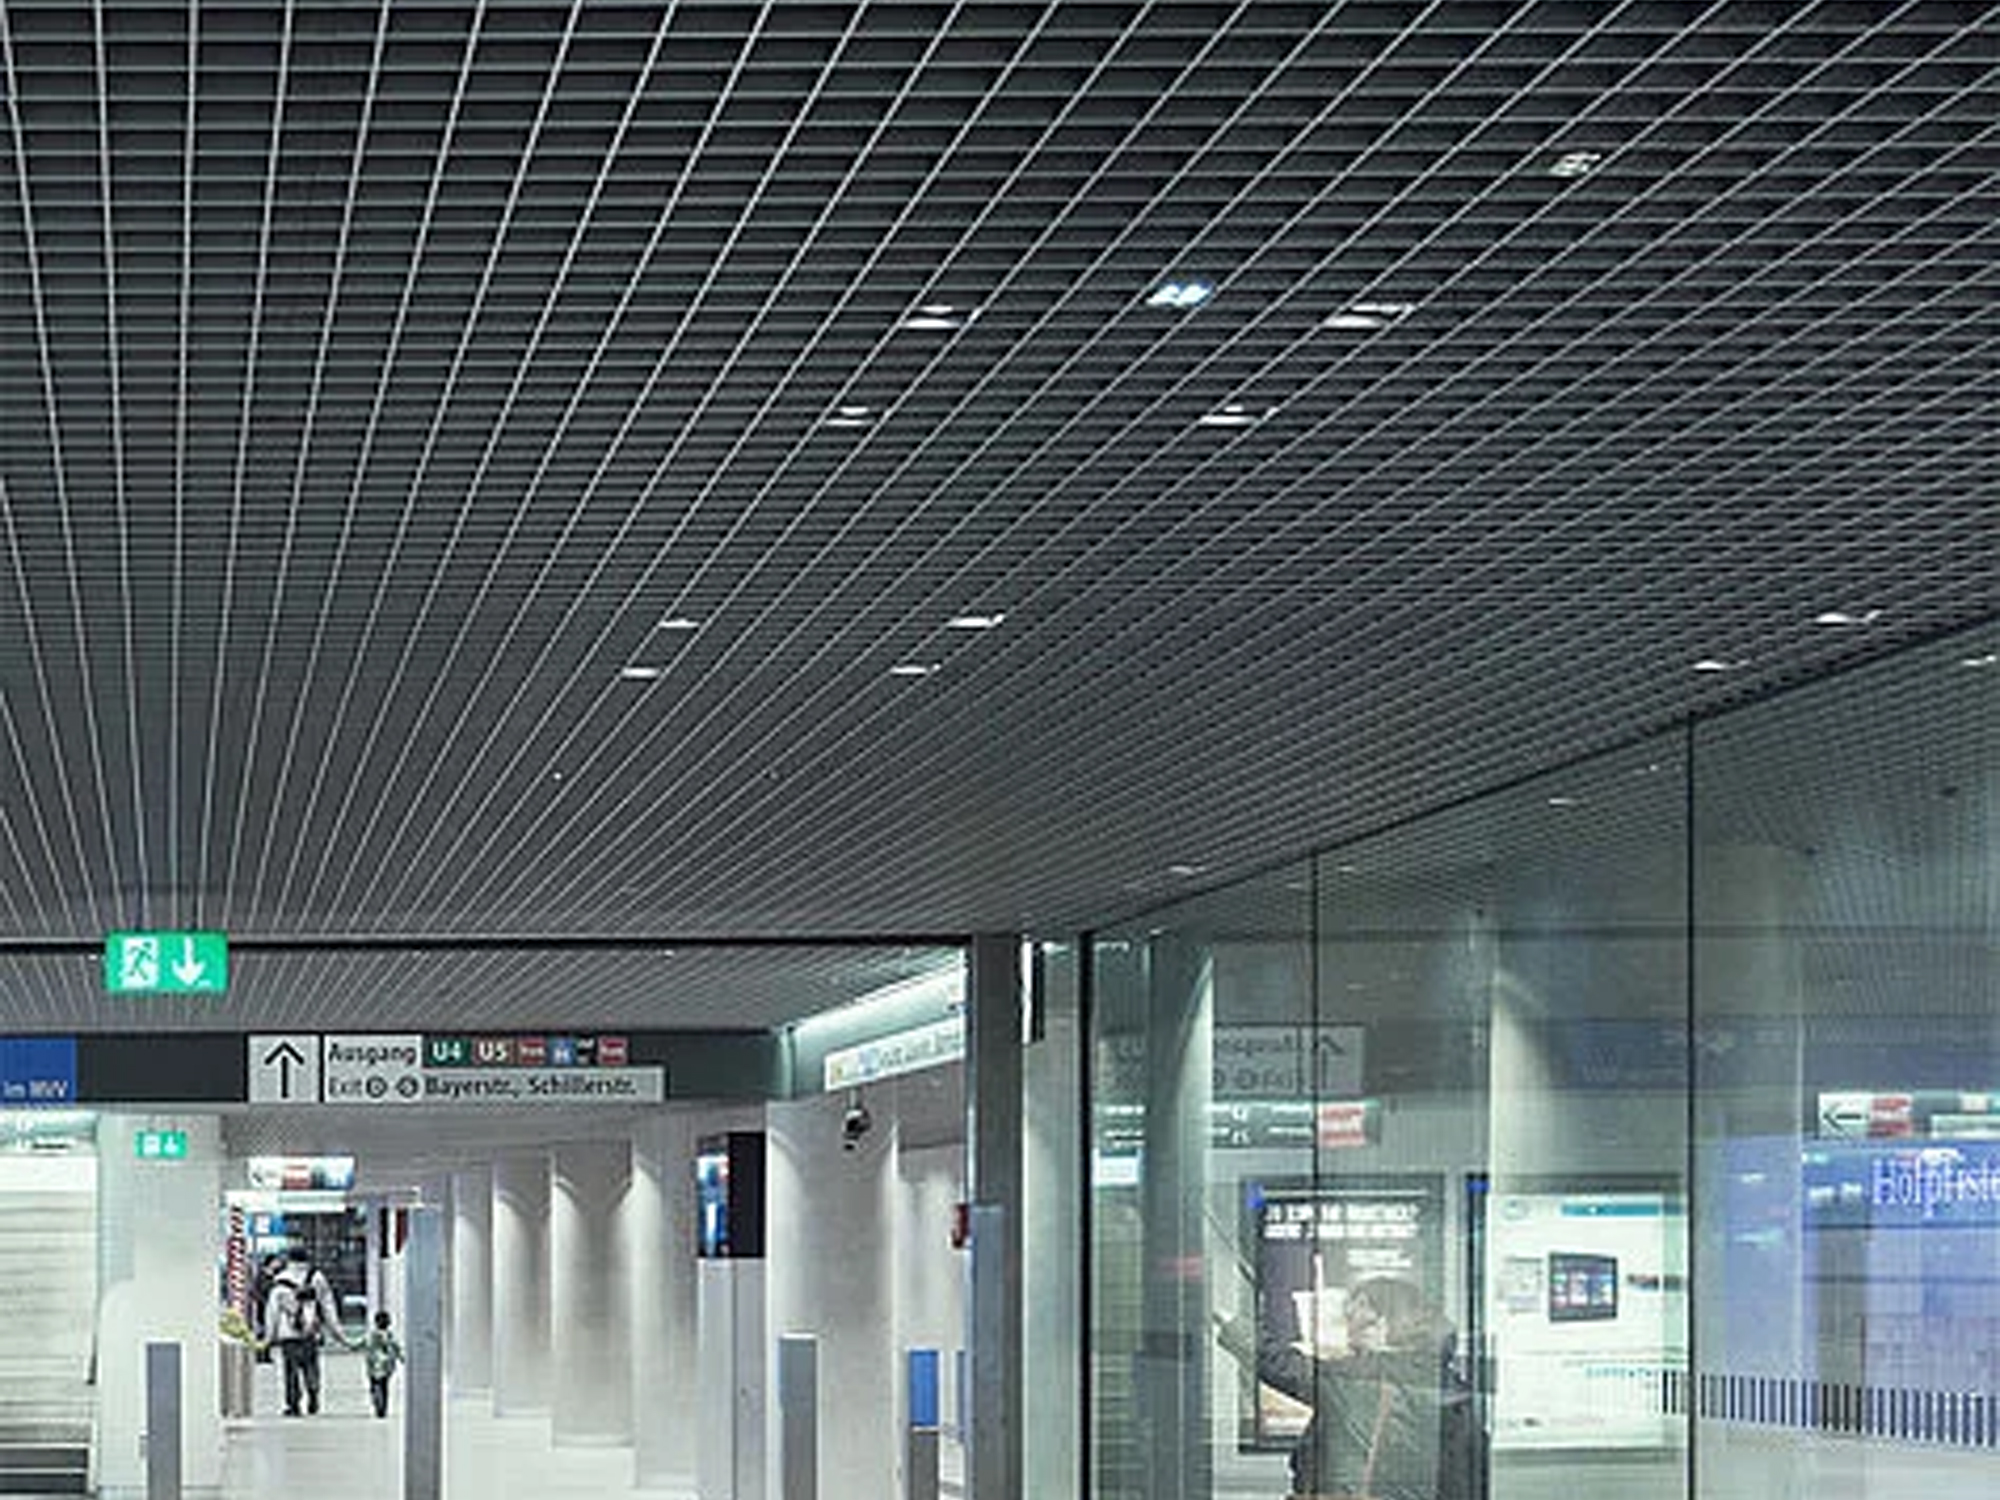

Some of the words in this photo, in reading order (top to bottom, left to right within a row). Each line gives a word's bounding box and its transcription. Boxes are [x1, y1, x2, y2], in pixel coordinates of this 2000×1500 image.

[329, 1043, 417, 1064] Ausgang
[432, 1041, 462, 1060] U4
[478, 1041, 507, 1060] U5
